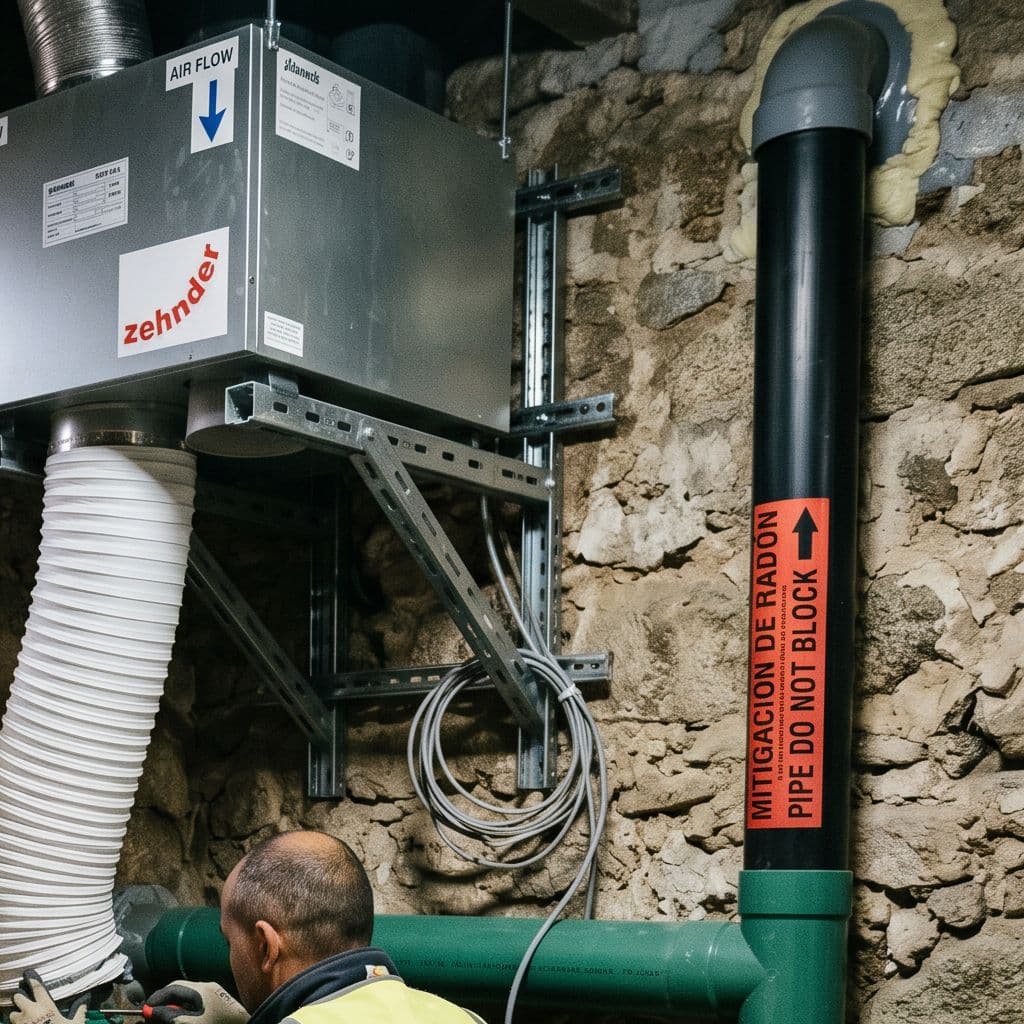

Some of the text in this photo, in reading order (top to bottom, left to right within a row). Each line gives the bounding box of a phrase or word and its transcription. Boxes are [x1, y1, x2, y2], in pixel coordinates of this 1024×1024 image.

[169, 48, 233, 81] AIR FLOW
[123, 243, 219, 345] zehnder
[755, 617, 775, 652] DE
[788, 568, 818, 819] PIPE DO NOT BLOCK
